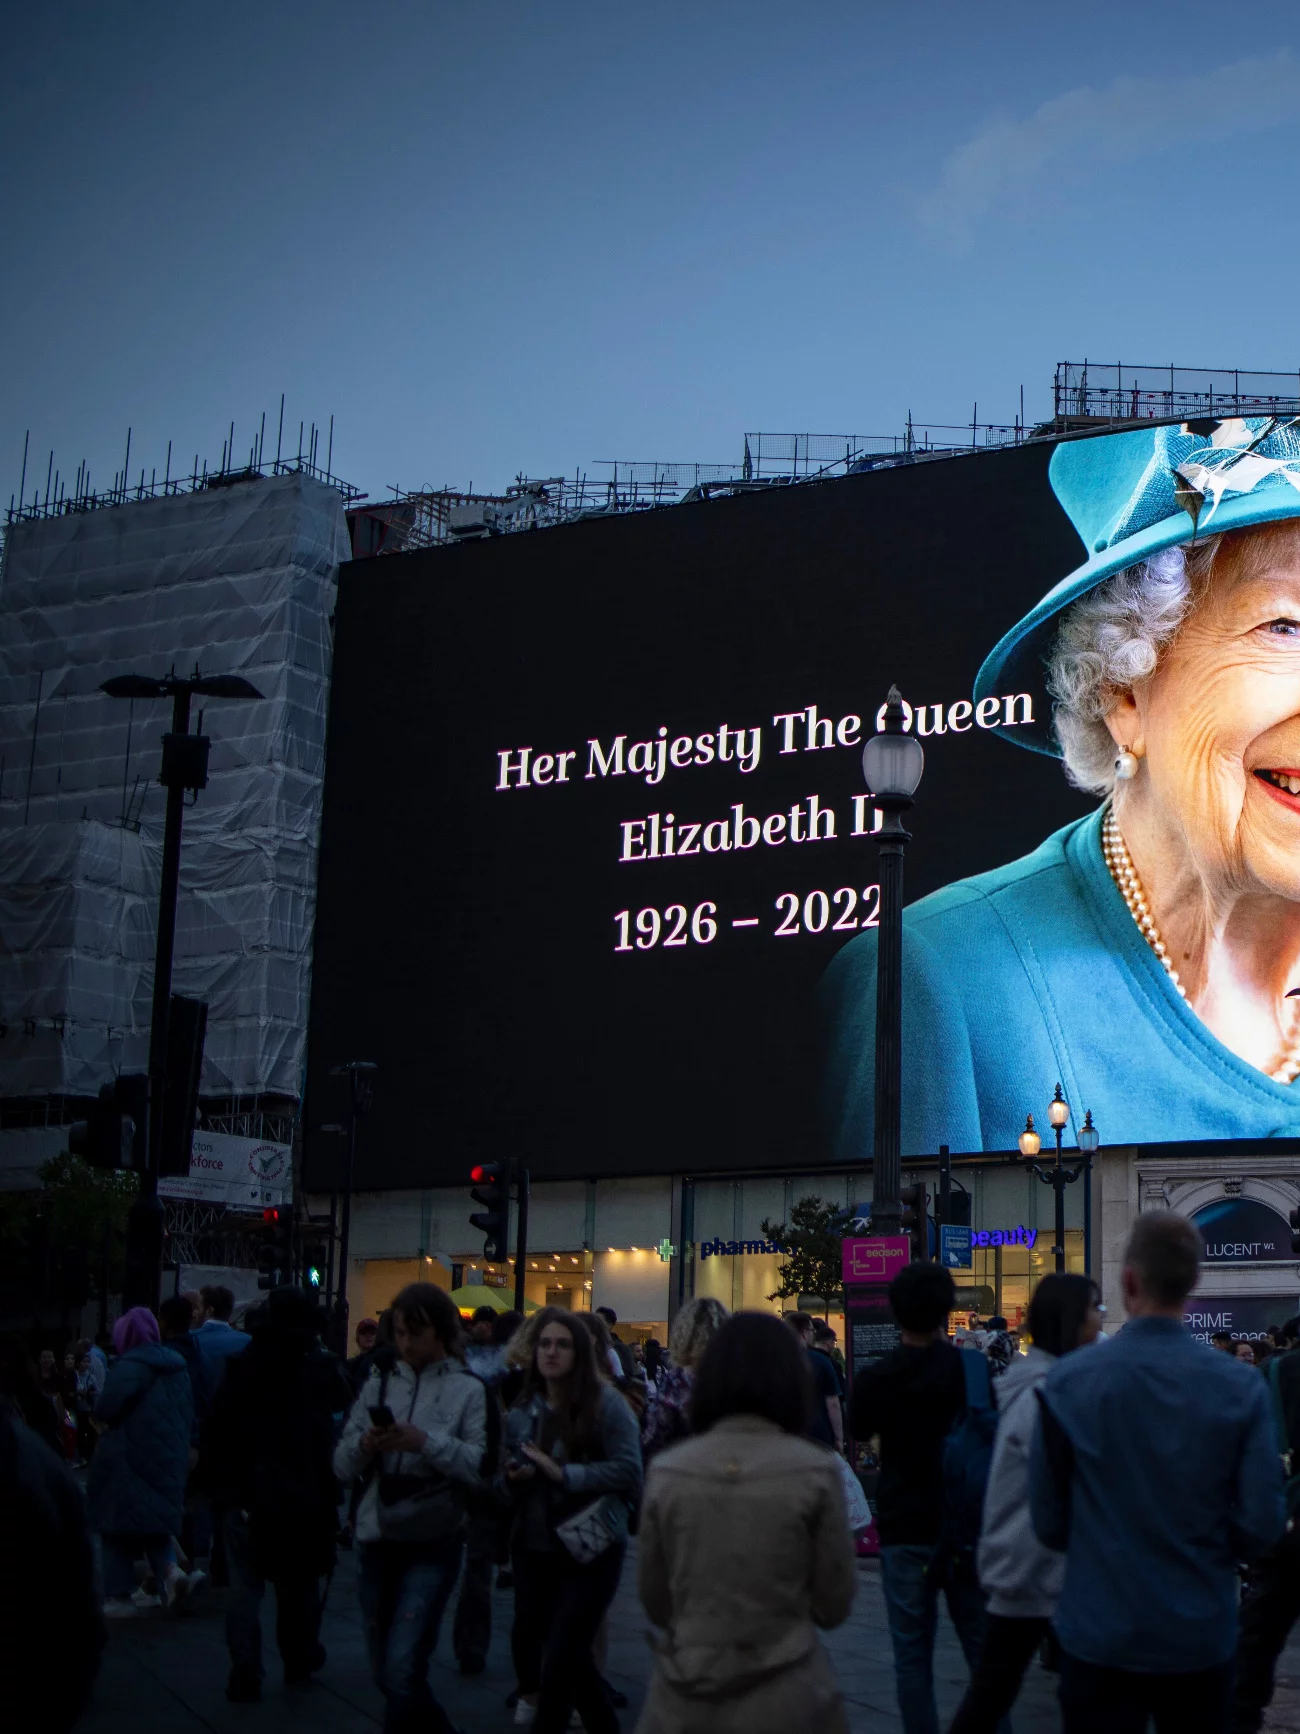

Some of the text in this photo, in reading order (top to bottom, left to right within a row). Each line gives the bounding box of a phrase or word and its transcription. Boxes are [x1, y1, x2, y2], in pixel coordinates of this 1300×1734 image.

[495, 746, 576, 791] Her
[584, 723, 762, 785] Majesty
[772, 705, 861, 751] The
[618, 793, 884, 863] Elizabeth II
[612, 900, 718, 952] 1926
[773, 884, 880, 937] 2022
[866, 1248, 904, 1258] season
[1206, 1242, 1276, 1257] LUCENT W1
[1183, 1312, 1233, 1328] PRIME
